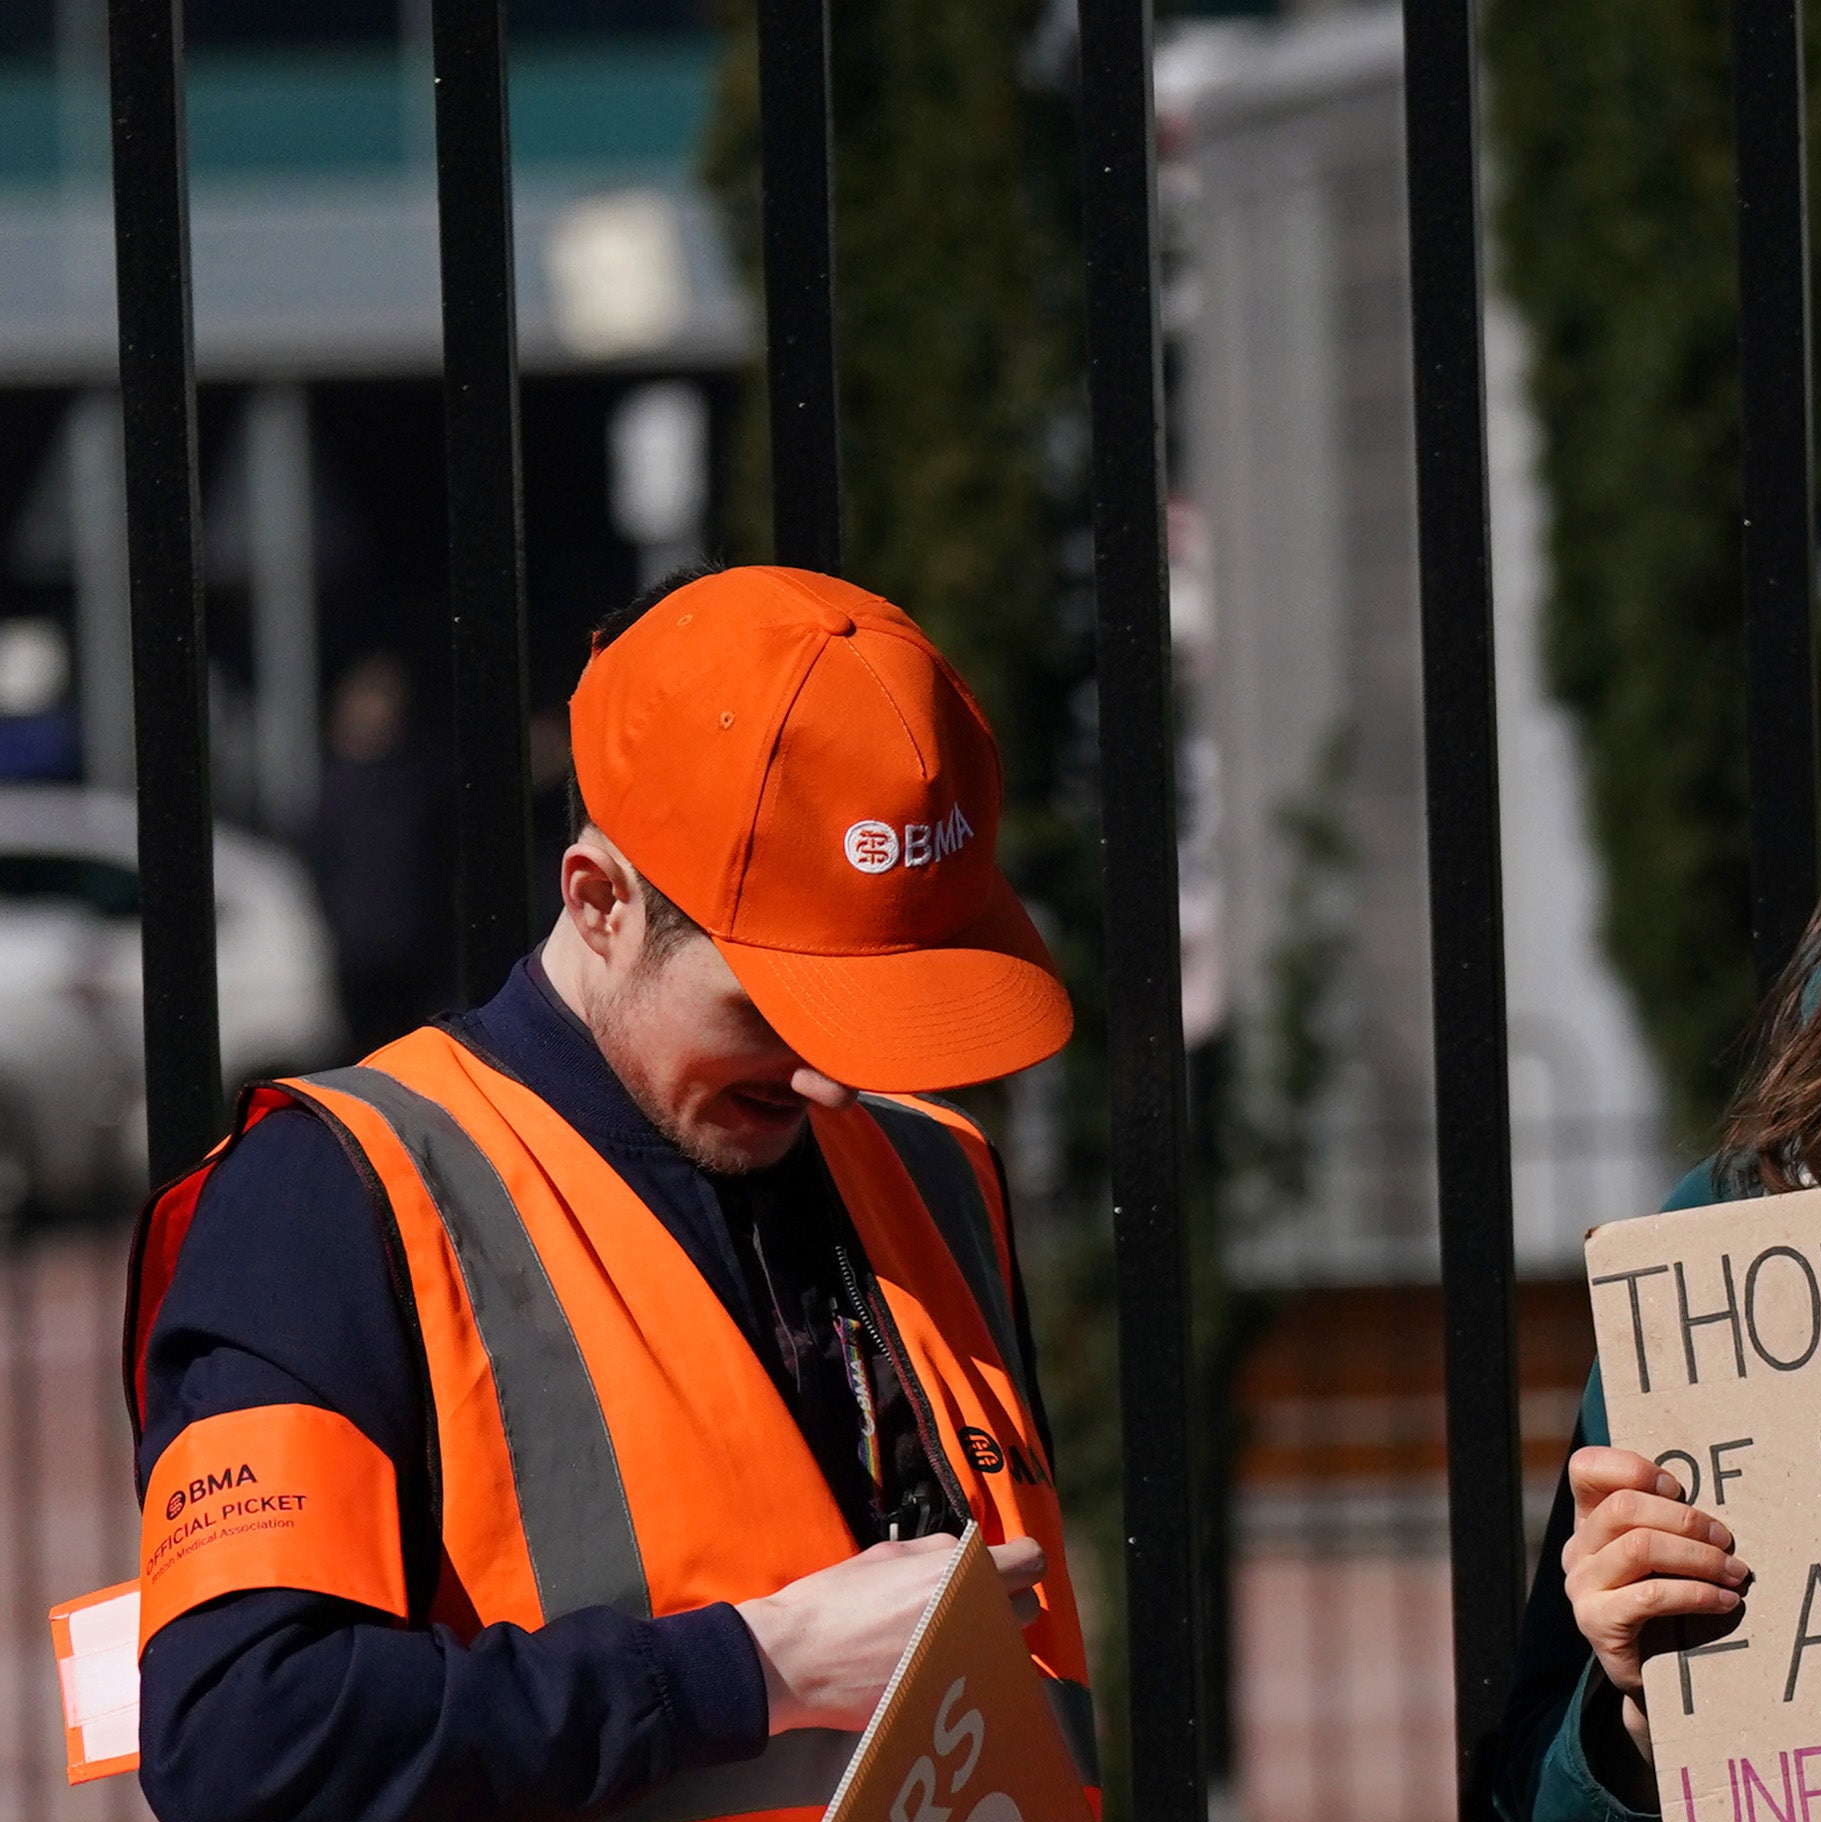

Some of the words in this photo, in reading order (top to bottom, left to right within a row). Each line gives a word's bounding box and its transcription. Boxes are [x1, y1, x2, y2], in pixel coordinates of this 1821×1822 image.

[904, 801, 975, 868] BMA
[189, 1464, 257, 1503] BMA
[147, 1513, 216, 1575] OFFICIAL
[222, 1495, 307, 1518] PICKET
[177, 1533, 216, 1558] Medical
[221, 1519, 294, 1537] Association
